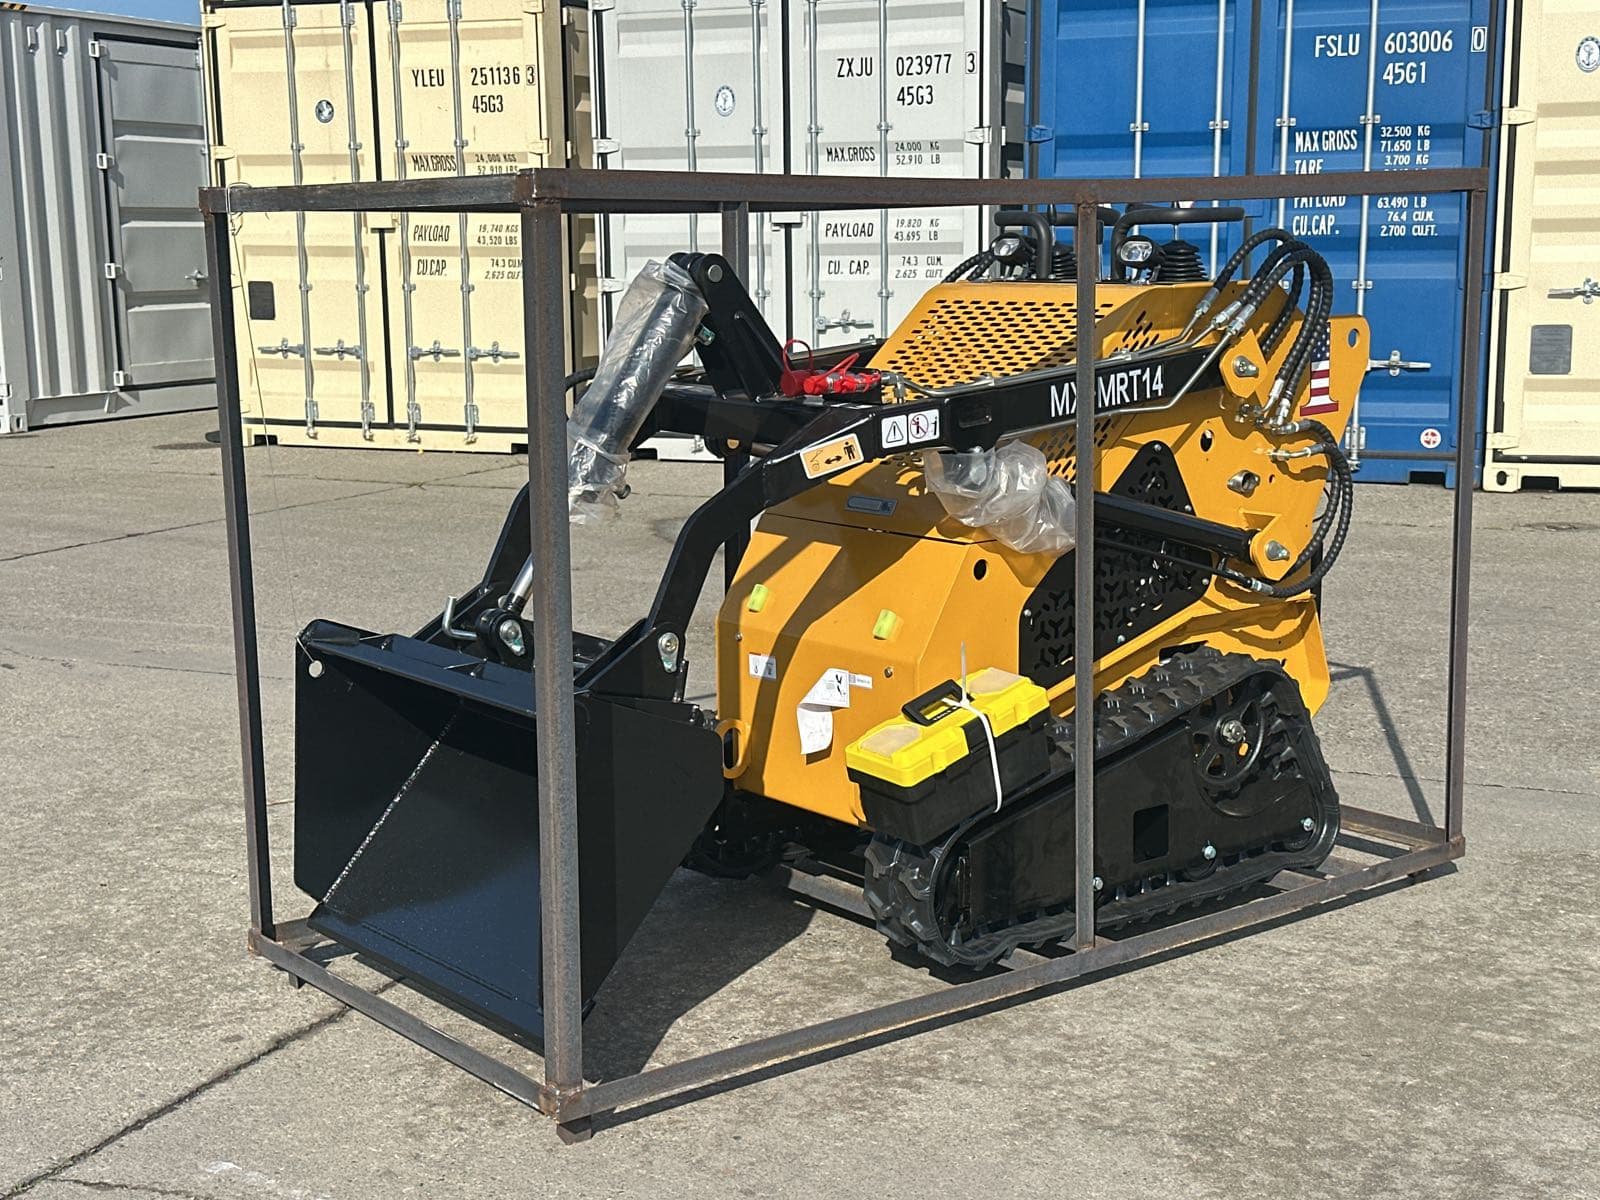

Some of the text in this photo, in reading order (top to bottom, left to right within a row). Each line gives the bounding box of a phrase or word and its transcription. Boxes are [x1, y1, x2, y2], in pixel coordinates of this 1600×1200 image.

[1315, 28, 1486, 58] FSLU 603006 0
[837, 52, 976, 78] ZXJU 023977 3
[412, 66, 536, 87] YLEU 251136 3
[1383, 61, 1426, 85] 45G1
[897, 85, 934, 106] 45G3
[472, 94, 504, 113] 45G3
[1380, 125, 1431, 137] 32.500 KG
[895, 141, 940, 152] 24.000 KG
[1295, 129, 1358, 153] MAX GROSS
[1380, 139, 1430, 152] 71.650 LB
[896, 154, 941, 165] 52.910 LB
[1384, 154, 1429, 166] 3.700 KG
[1377, 196, 1427, 208] 63.490 LB
[930, 218, 940, 228] KG
[1387, 211, 1407, 222] 76.4
[413, 224, 451, 242] PAYLOAD
[505, 224, 519, 233] KGS
[825, 222, 874, 238] PAYLOAD
[1380, 224, 1406, 237] 2.700
[505, 236, 518, 245] LBS
[894, 231, 939, 242] 43.695 LB
[901, 255, 918, 266] 74.3
[1097, 365, 1164, 409] MRT14
